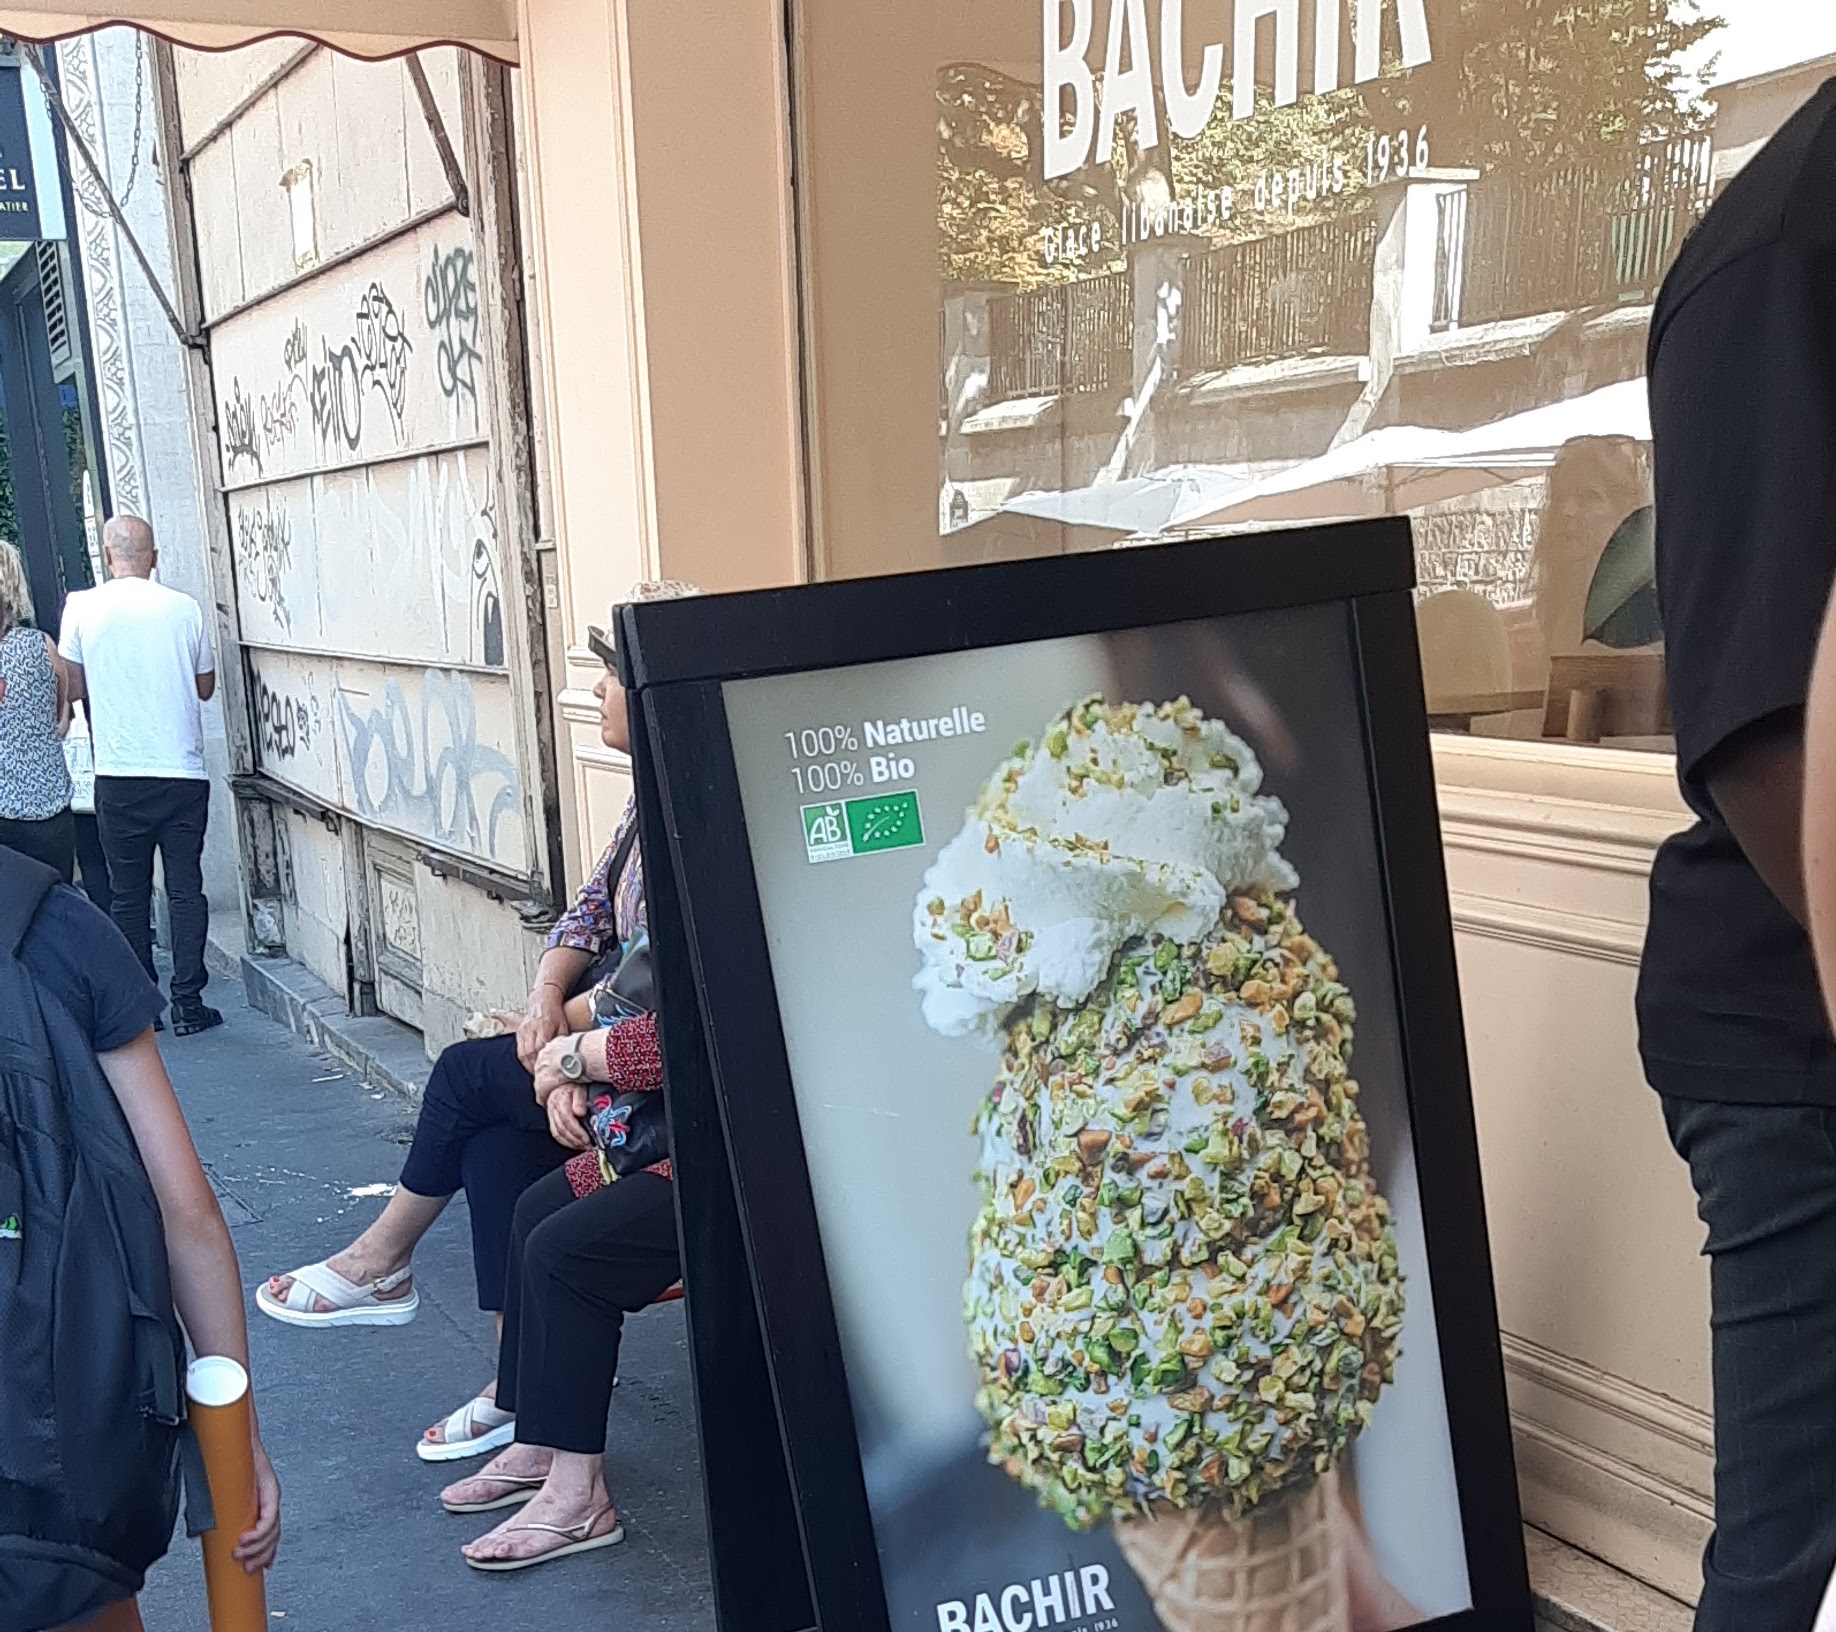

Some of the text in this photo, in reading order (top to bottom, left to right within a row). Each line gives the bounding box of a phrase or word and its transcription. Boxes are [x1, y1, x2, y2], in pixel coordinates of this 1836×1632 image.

[1043, 124, 1430, 263] Glace libanaise depuis 1936
[784, 706, 986, 759] 100% Naturelle
[791, 752, 915, 794] 100% Bio
[810, 816, 841, 845] AB
[1094, 1617, 1119, 1632] 1936
